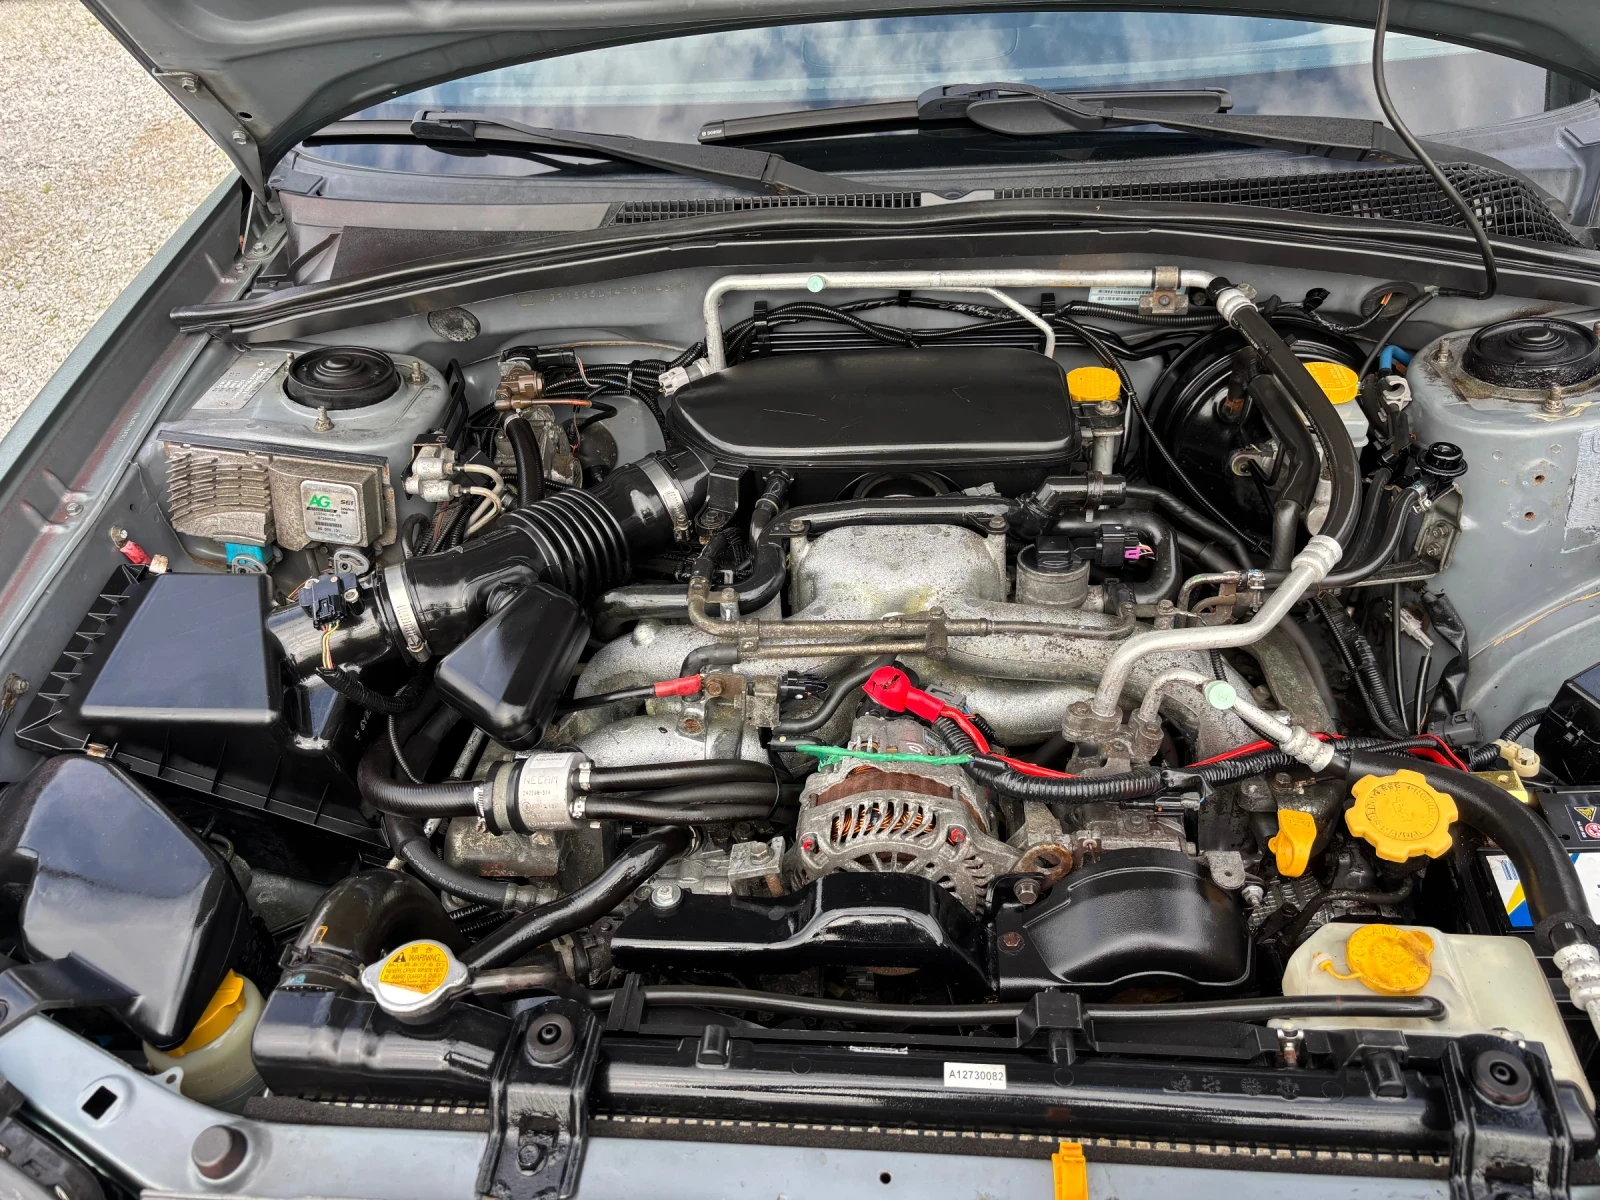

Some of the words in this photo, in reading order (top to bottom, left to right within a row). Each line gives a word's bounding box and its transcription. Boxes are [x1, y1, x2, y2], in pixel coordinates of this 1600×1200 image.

[308, 494, 331, 508] AG
[523, 775, 559, 785] NECAM
[408, 953, 441, 962] WARNING
[948, 1069, 1004, 1082] A12730082
